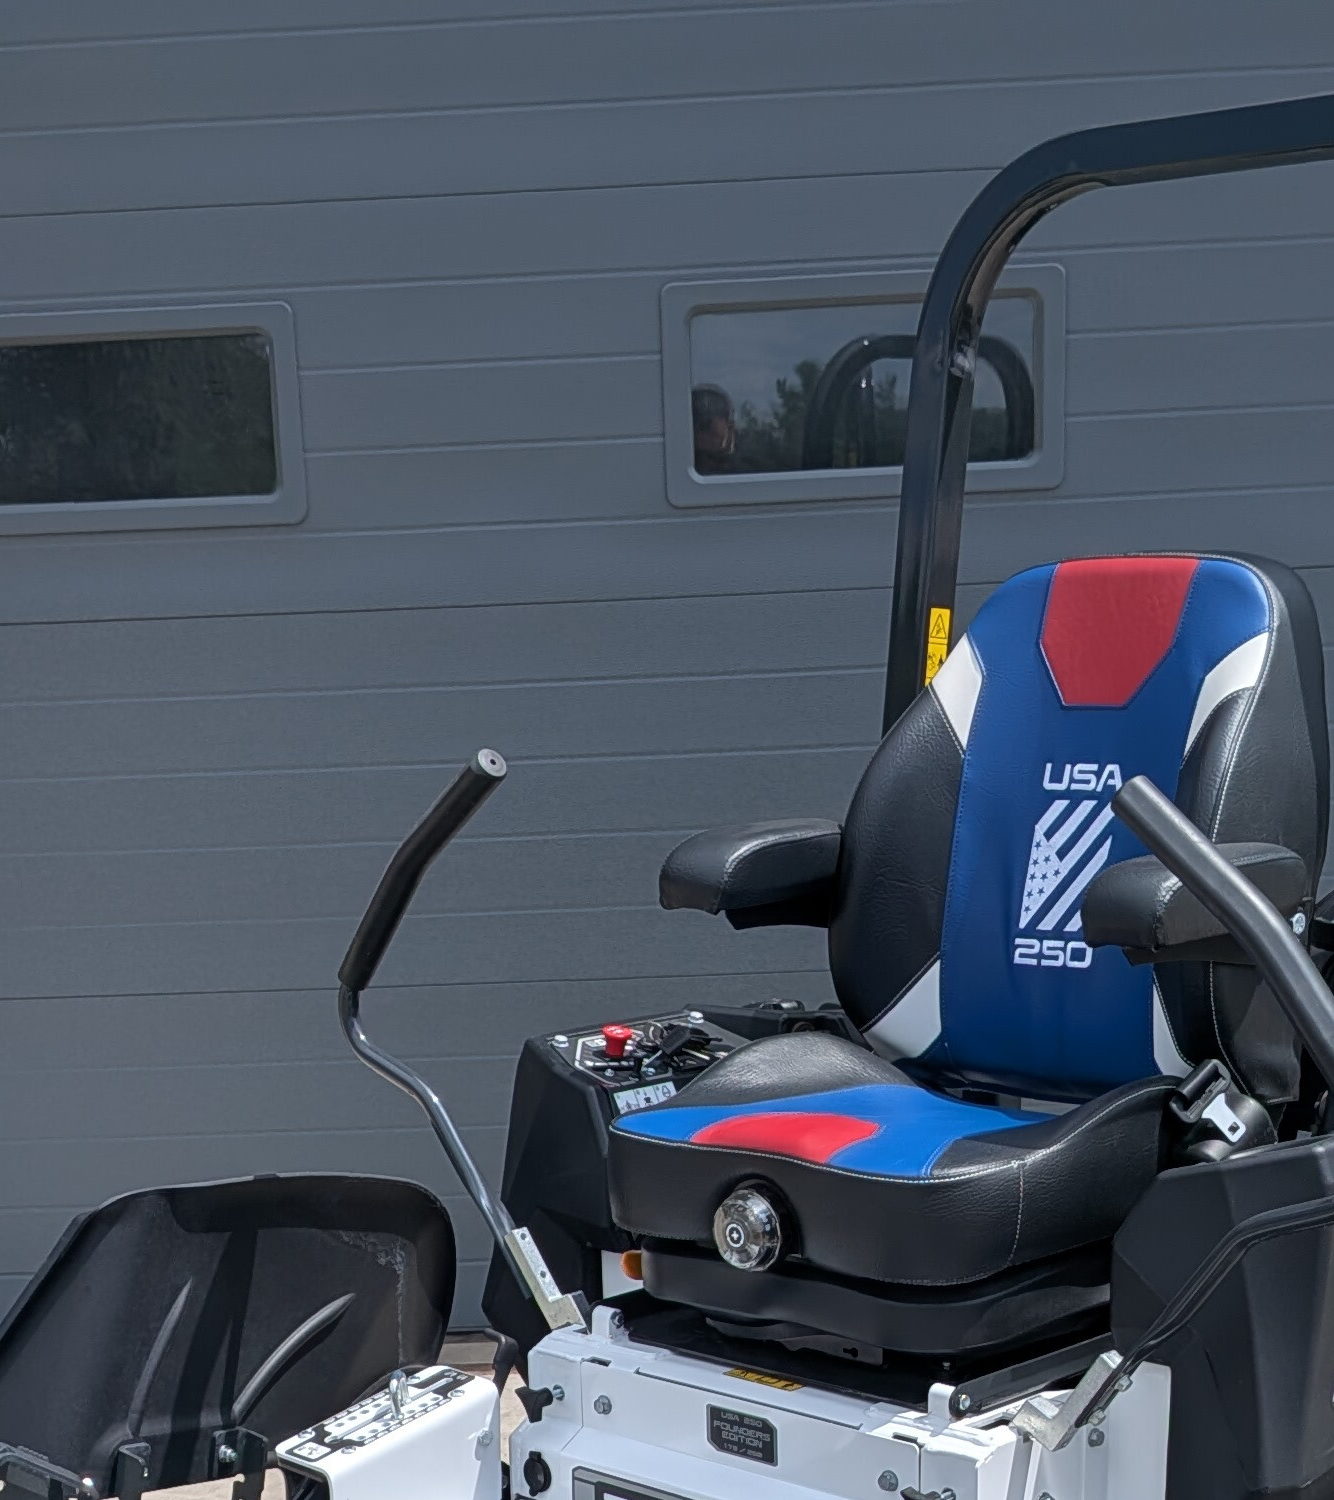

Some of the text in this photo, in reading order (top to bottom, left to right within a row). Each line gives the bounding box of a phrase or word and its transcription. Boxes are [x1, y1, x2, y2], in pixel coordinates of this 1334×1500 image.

[1043, 763, 1123, 792] USA
[1013, 937, 1094, 969] 250
[720, 1411, 740, 1422] USA
[713, 1419, 771, 1442] FOUNDERS
[721, 1430, 763, 1448] EDITION
